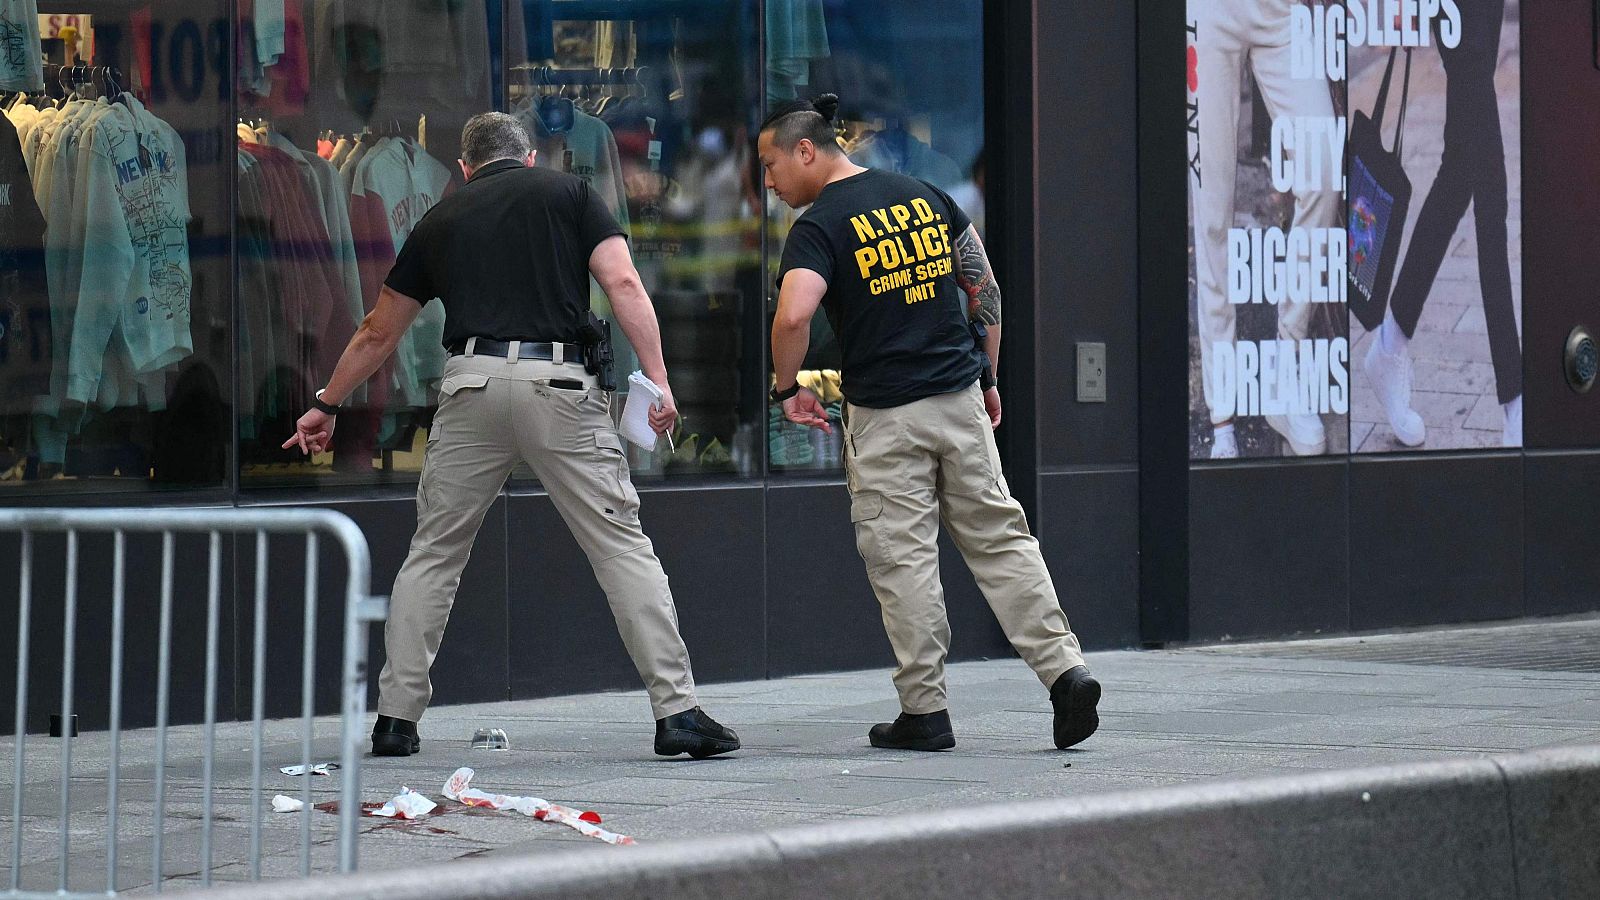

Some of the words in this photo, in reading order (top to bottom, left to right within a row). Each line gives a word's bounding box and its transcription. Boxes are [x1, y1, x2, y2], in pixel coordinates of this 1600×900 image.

[1291, 4, 1346, 82] BIG
[1347, 0, 1462, 49] SLEEPS
[1271, 116, 1346, 200] CITY,
[850, 197, 941, 244] N.Y.P.D.
[854, 223, 952, 280] POLICE
[1227, 226, 1347, 305] BIGGER
[869, 268, 913, 296] CRIME
[904, 281, 936, 305] UNIT
[1212, 337, 1348, 417] DREAMS
